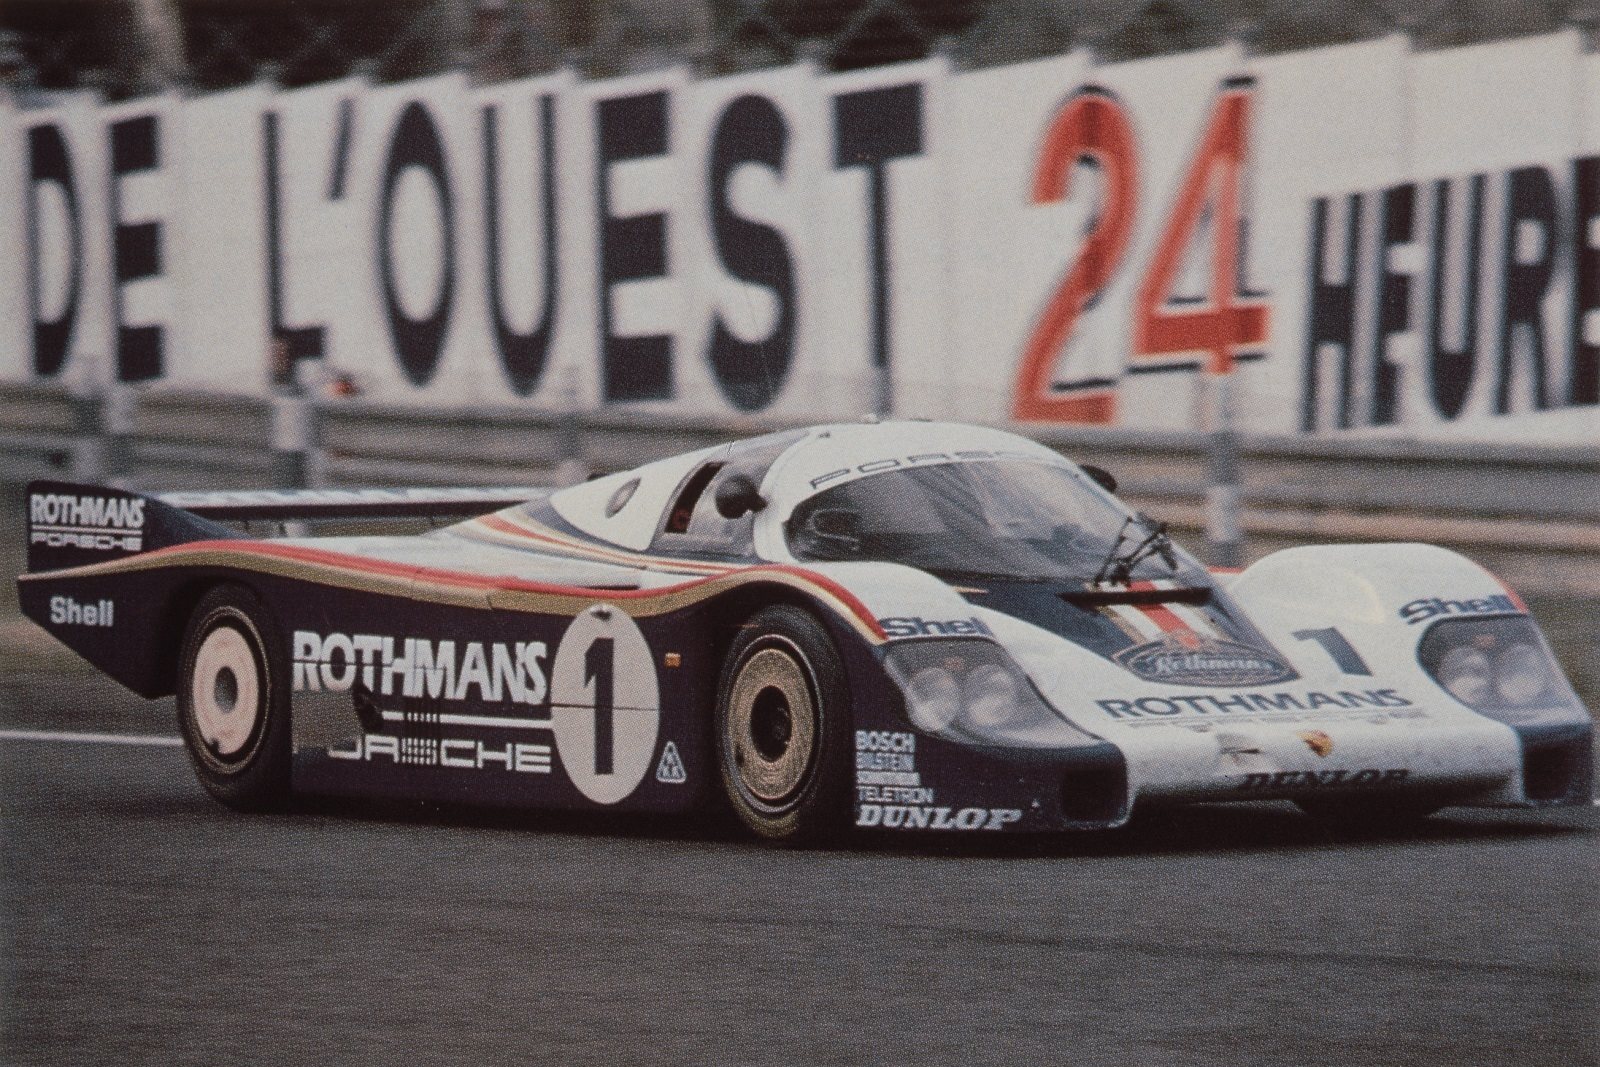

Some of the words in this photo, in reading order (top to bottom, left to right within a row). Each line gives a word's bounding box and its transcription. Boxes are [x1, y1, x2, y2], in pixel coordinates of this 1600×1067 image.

[28, 115, 164, 382] DE
[261, 80, 926, 412] L'OUEST
[1011, 75, 1269, 423] 24
[30, 494, 144, 528] ROTHMANS
[31, 531, 142, 551] PORSCHE
[50, 596, 114, 627] Shell
[879, 616, 994, 636] Shell
[292, 630, 547, 705] ROTHMANS
[1290, 627, 1373, 677] 1
[584, 636, 614, 775] 1
[1098, 688, 1414, 719] ROTHMANS
[856, 730, 916, 753] BOSCH
[856, 804, 1023, 830] DUNLOP
